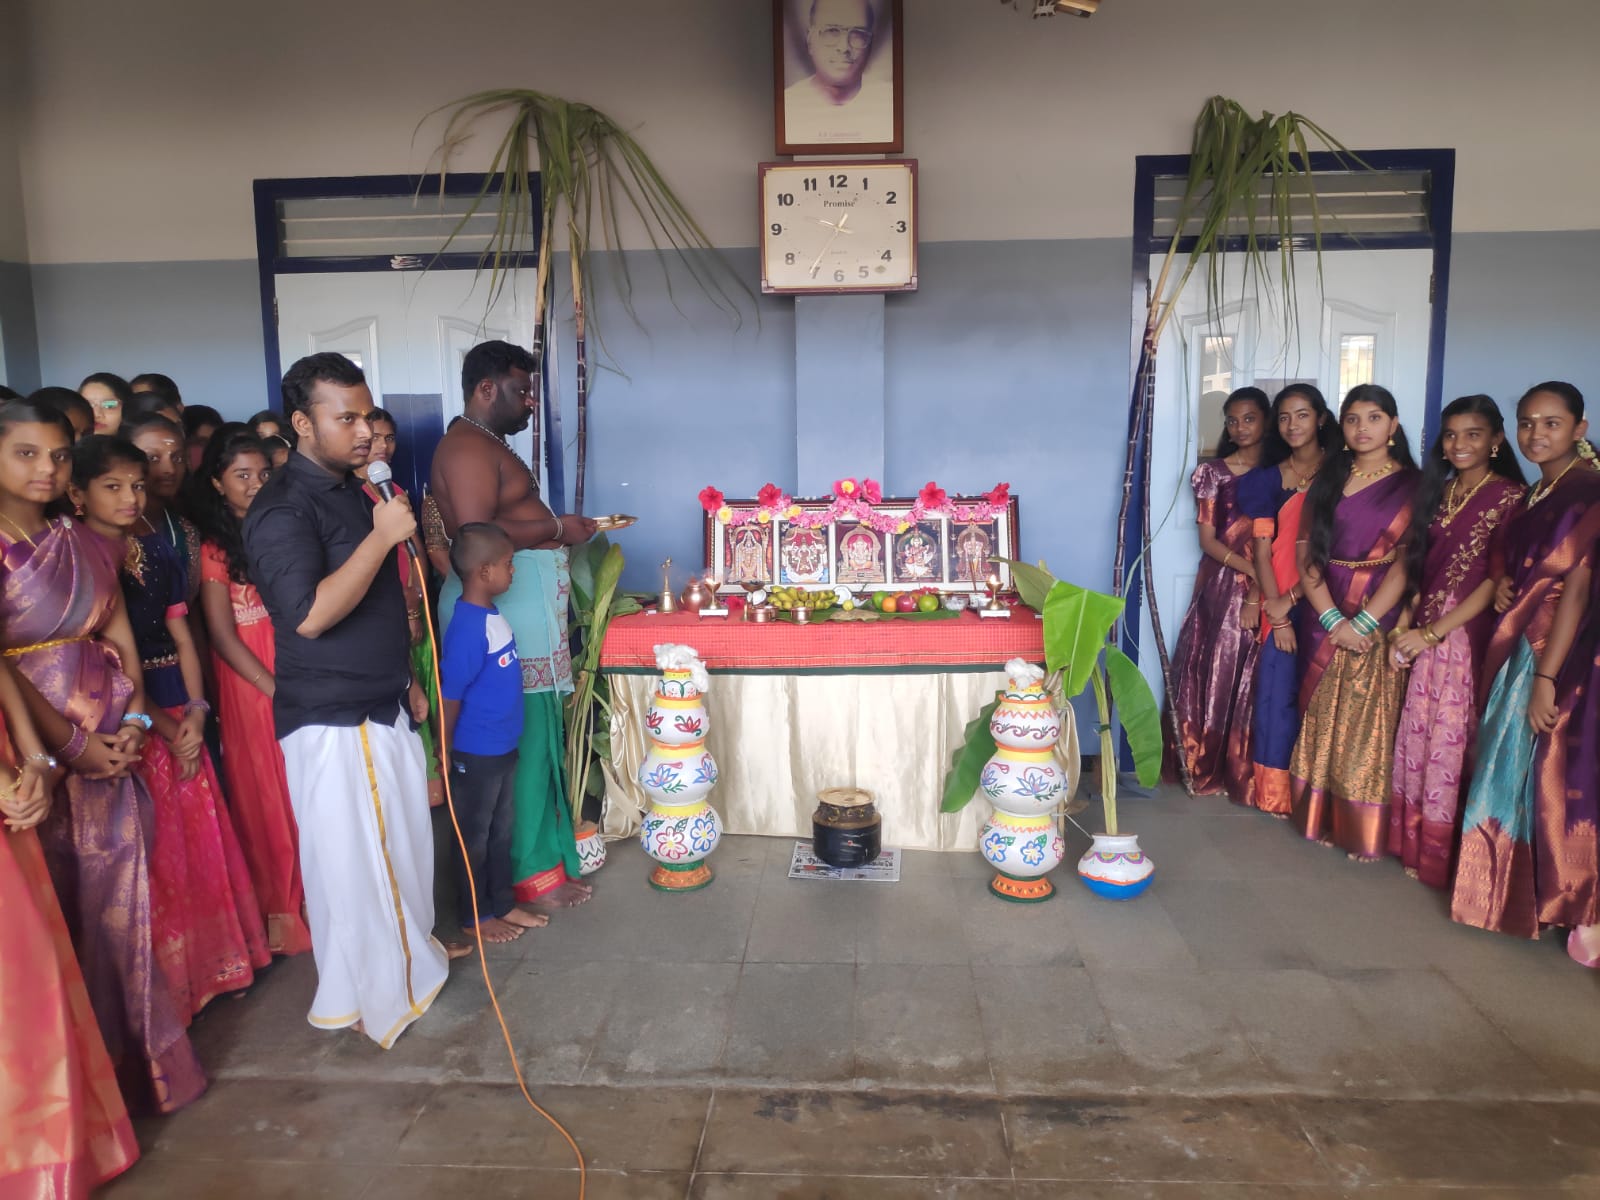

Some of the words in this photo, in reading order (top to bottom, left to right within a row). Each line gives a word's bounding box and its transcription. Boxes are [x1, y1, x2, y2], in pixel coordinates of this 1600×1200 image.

[803, 177, 817, 191] 11
[828, 174, 848, 188] 12
[862, 177, 868, 191] 1
[777, 193, 794, 207] 10
[823, 199, 856, 208] Promise
[886, 191, 897, 205] 2
[771, 223, 782, 236] 9
[896, 220, 907, 233] 3
[785, 252, 796, 265] 8
[880, 250, 892, 262] 4
[810, 266, 820, 280] 7
[833, 269, 845, 283] 6
[858, 265, 869, 279] 5
